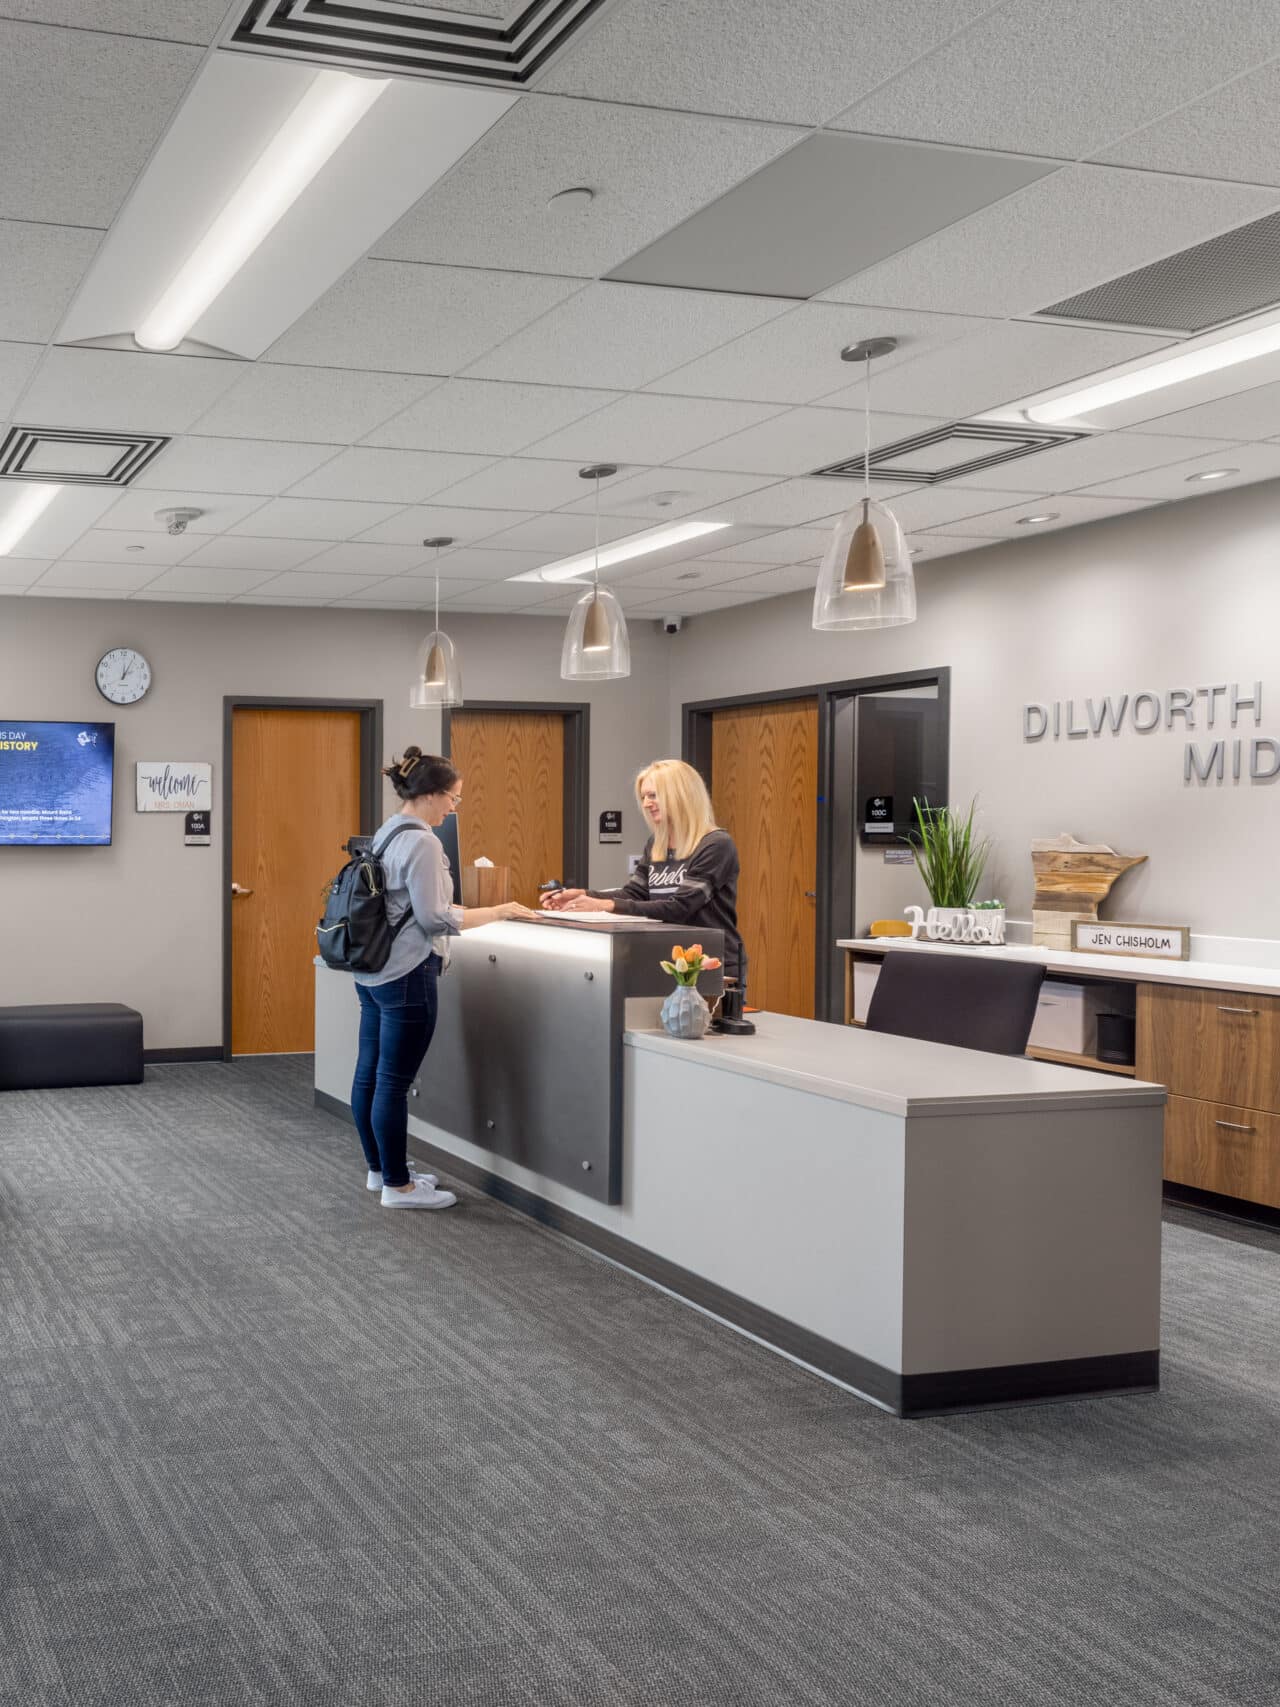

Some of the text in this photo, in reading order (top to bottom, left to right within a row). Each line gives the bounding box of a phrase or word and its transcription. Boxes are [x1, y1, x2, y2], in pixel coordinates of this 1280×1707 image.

[1022, 680, 1263, 739] DILWORTH
[1183, 737, 1280, 781] MID
[141, 764, 208, 800] welcome
[1091, 933, 1172, 949] JEN CHISHOLM
